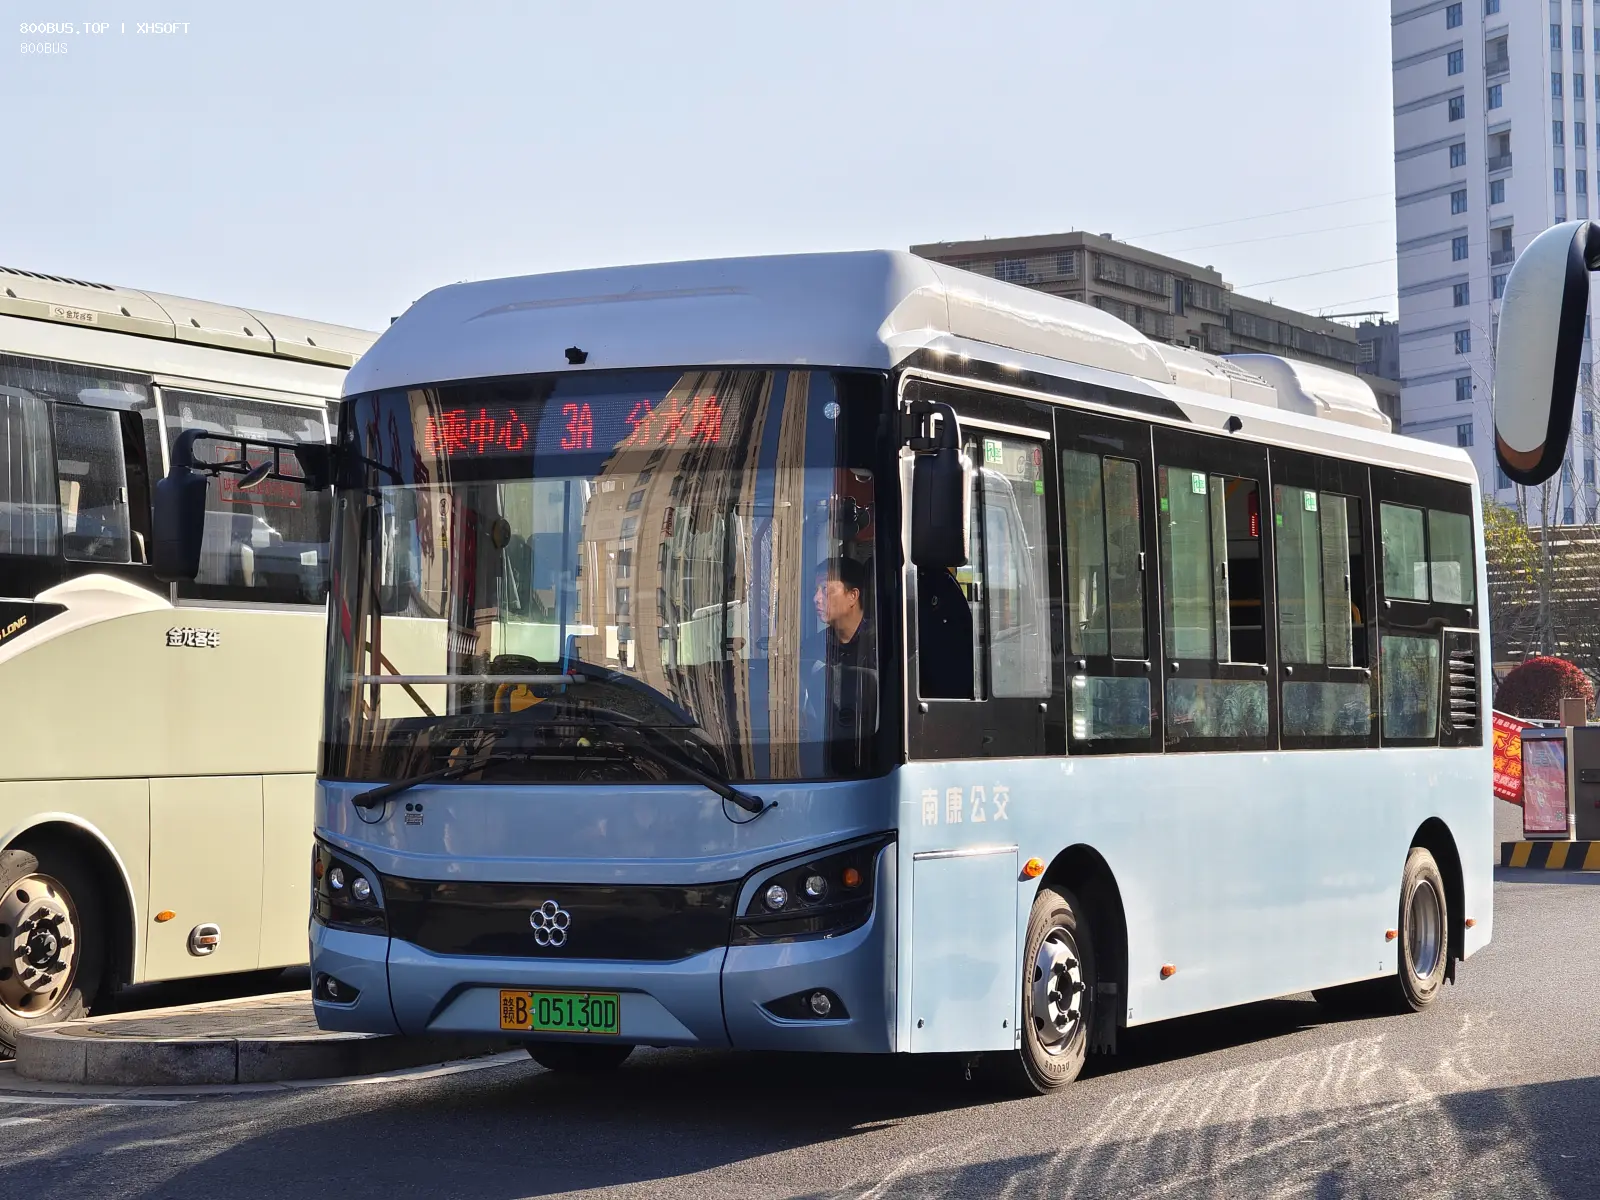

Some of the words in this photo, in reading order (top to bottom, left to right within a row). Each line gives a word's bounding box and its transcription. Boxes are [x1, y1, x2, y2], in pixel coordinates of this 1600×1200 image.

[561, 402, 593, 450] 3A
[1, 615, 27, 638] LONG
[165, 626, 221, 648] 金龙客车
[921, 784, 1010, 826] 南康公交
[502, 996, 529, 1025] 赣B
[538, 997, 616, 1028] 05130D
